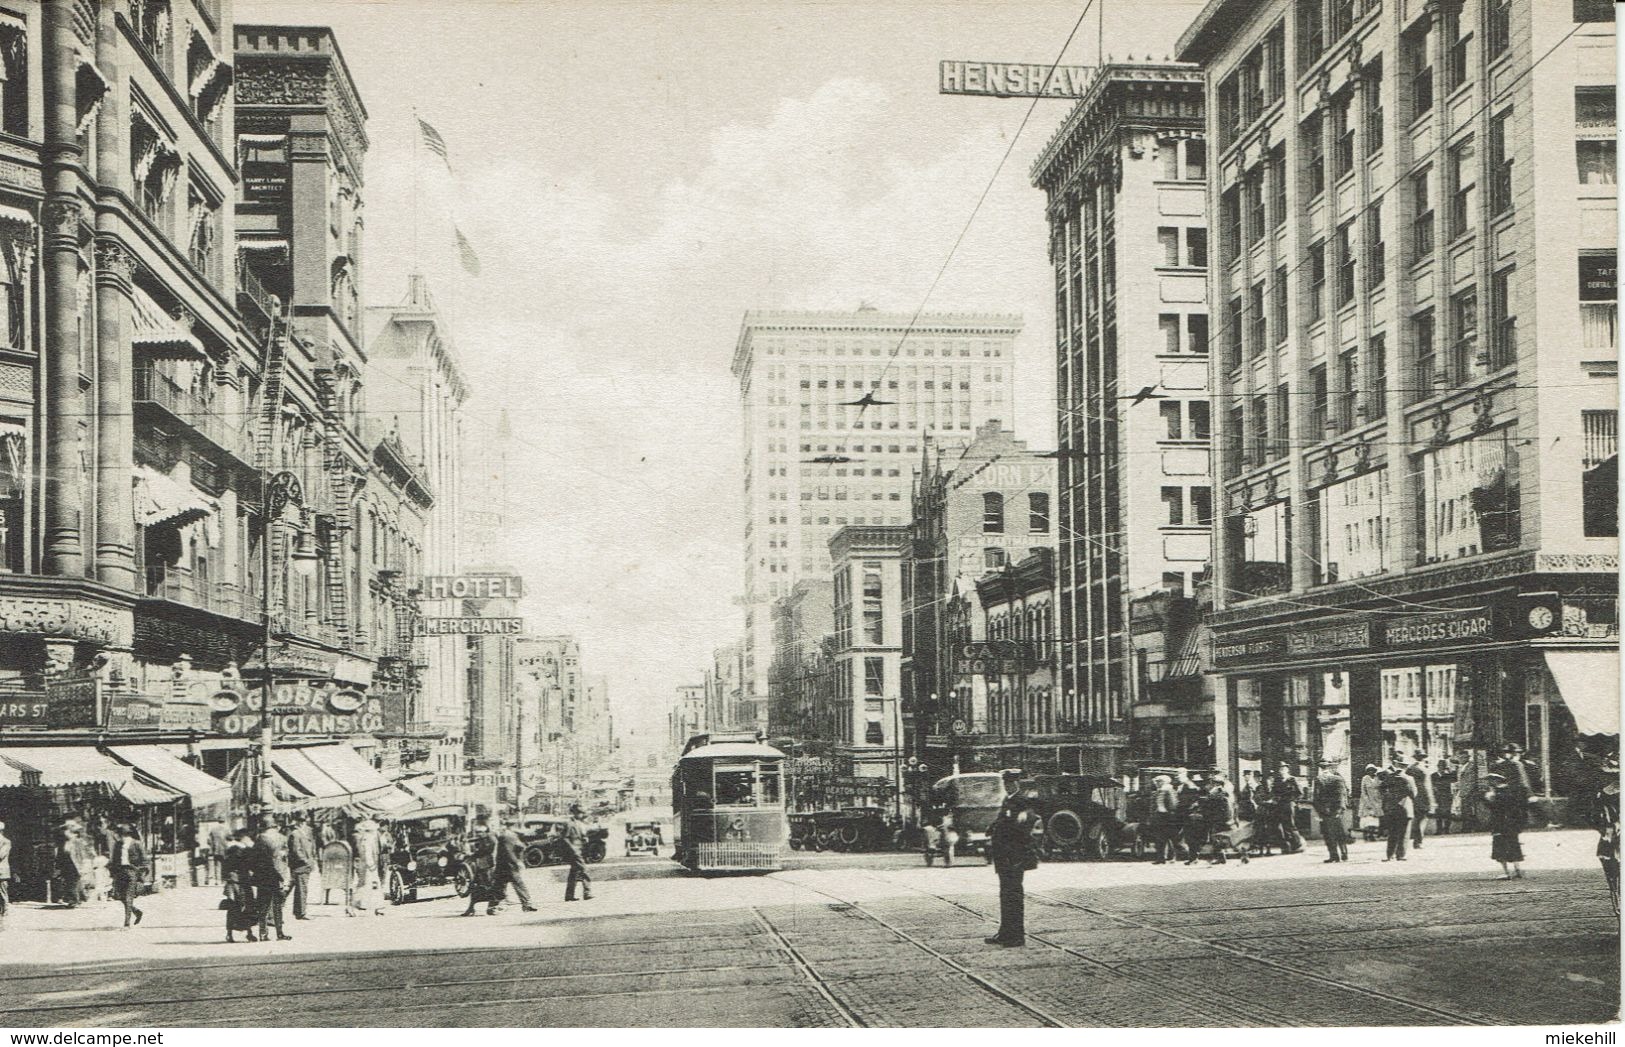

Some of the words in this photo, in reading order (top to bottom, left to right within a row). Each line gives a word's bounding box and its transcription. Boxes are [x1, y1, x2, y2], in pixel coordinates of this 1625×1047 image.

[942, 61, 1097, 96] HENSHAW
[431, 577, 519, 598] HOTEL
[426, 619, 521, 633] MERCHANTS
[1384, 622, 1446, 645] MERCEDES
[246, 684, 329, 712] GLOBE
[224, 714, 353, 735] OPICIANS
